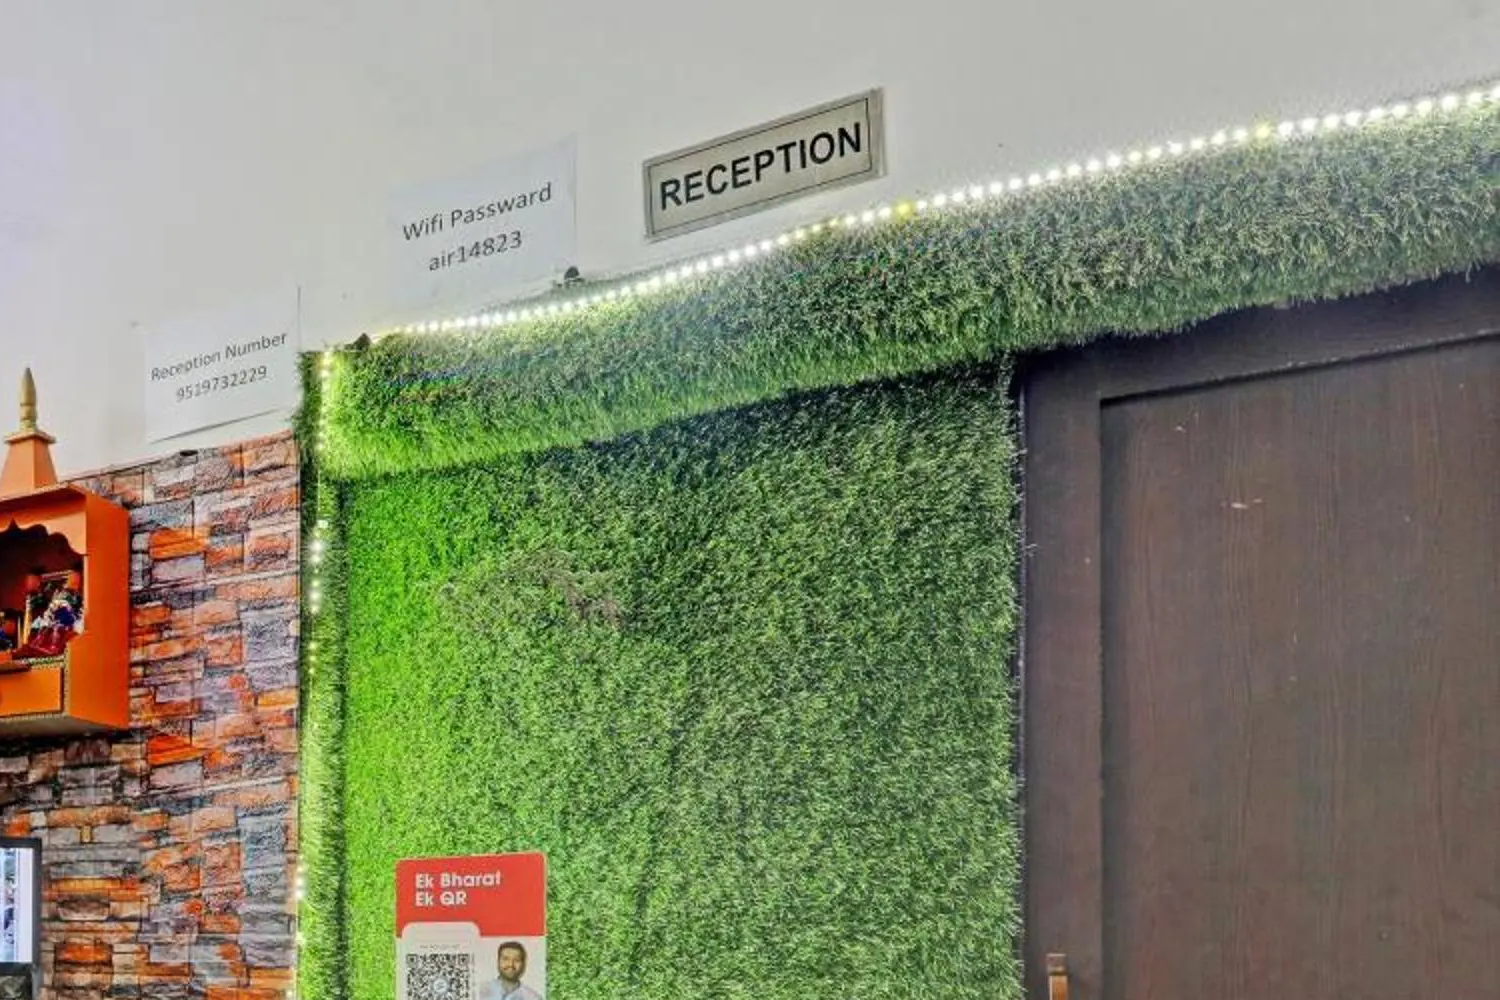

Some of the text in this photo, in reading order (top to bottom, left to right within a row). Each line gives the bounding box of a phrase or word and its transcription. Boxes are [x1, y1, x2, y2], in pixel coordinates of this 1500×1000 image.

[660, 122, 861, 210] RECEPTION
[403, 181, 552, 241] Wifi Passward
[429, 230, 522, 271] air14823
[150, 333, 287, 381] Reception Number
[415, 870, 501, 889] Ek Bharat
[415, 890, 467, 907] Ek QR
